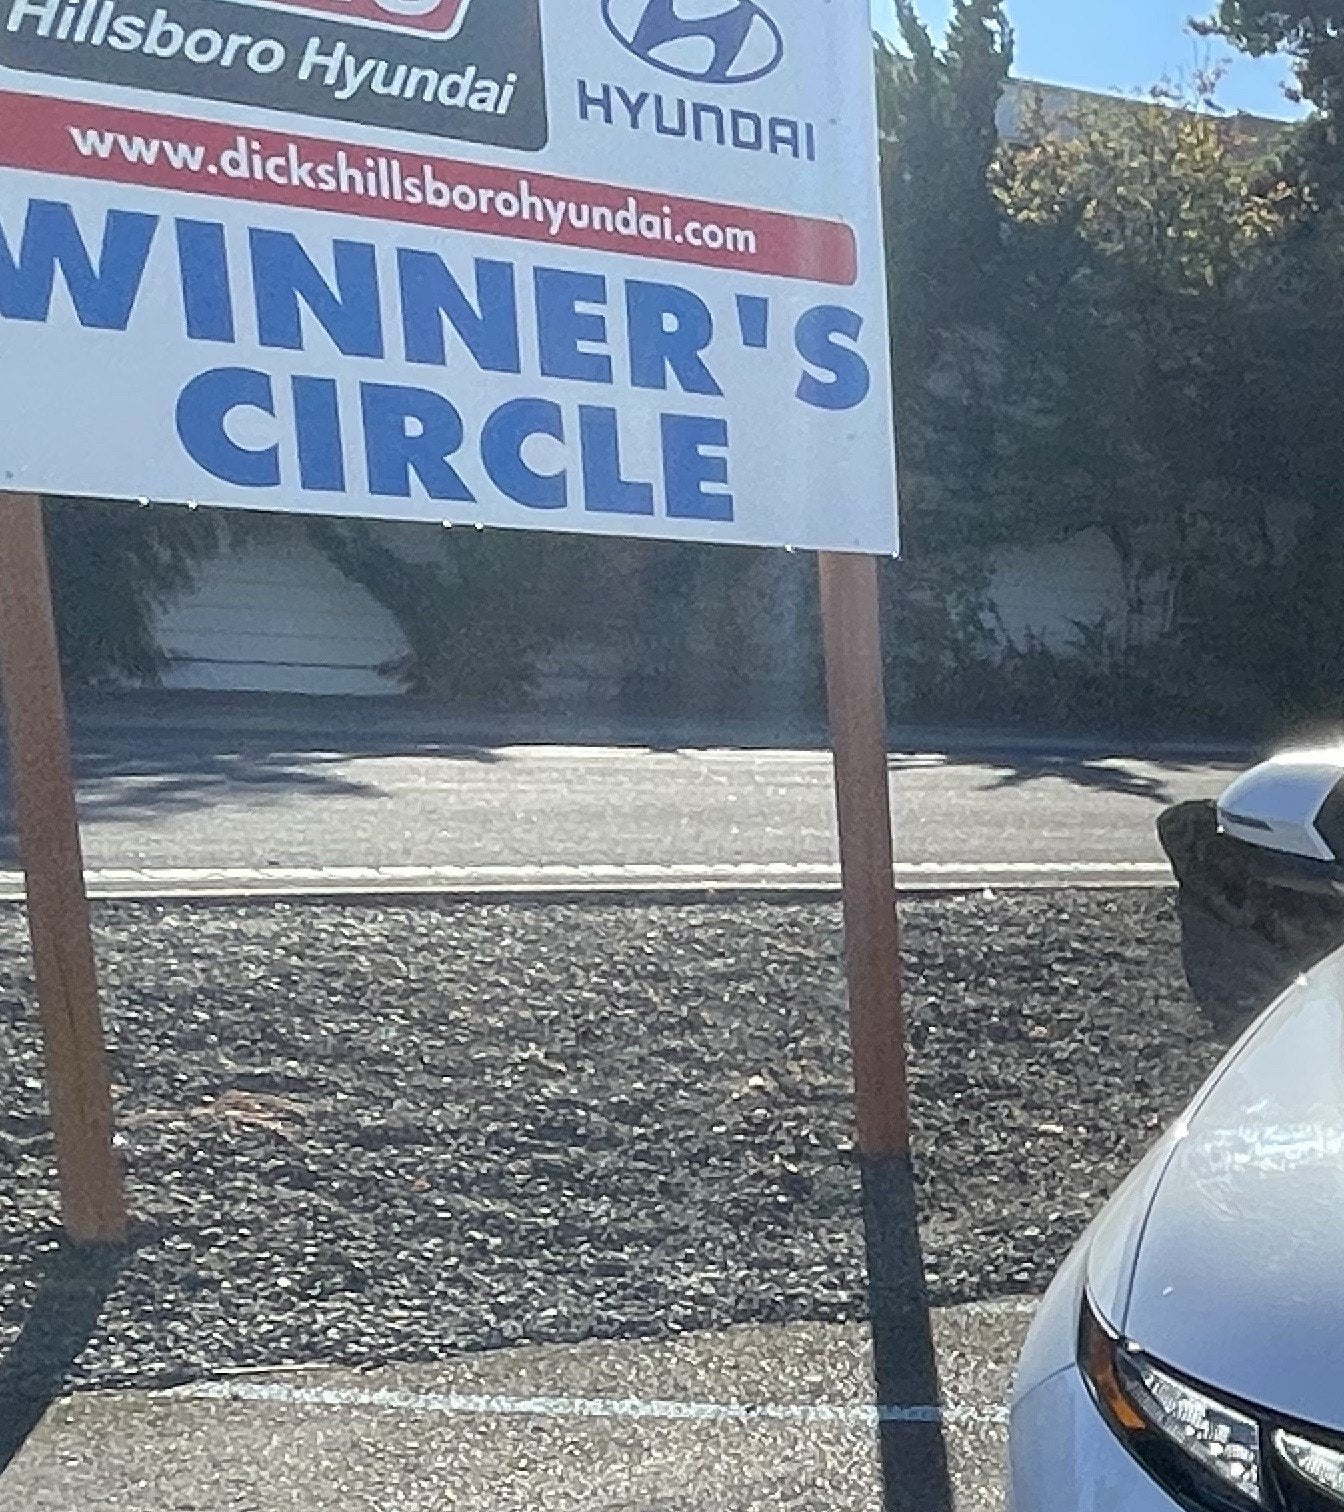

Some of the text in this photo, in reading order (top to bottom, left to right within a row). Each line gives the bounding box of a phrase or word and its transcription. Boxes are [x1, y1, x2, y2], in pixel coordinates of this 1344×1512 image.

[6, 0, 518, 116] Hillsboro Hyundai
[577, 79, 816, 162] HYUNDAI
[68, 124, 758, 256] www.dickshillsborohyundai.com
[0, 198, 871, 409] WINNER'S
[174, 366, 736, 523] CIRCLE
